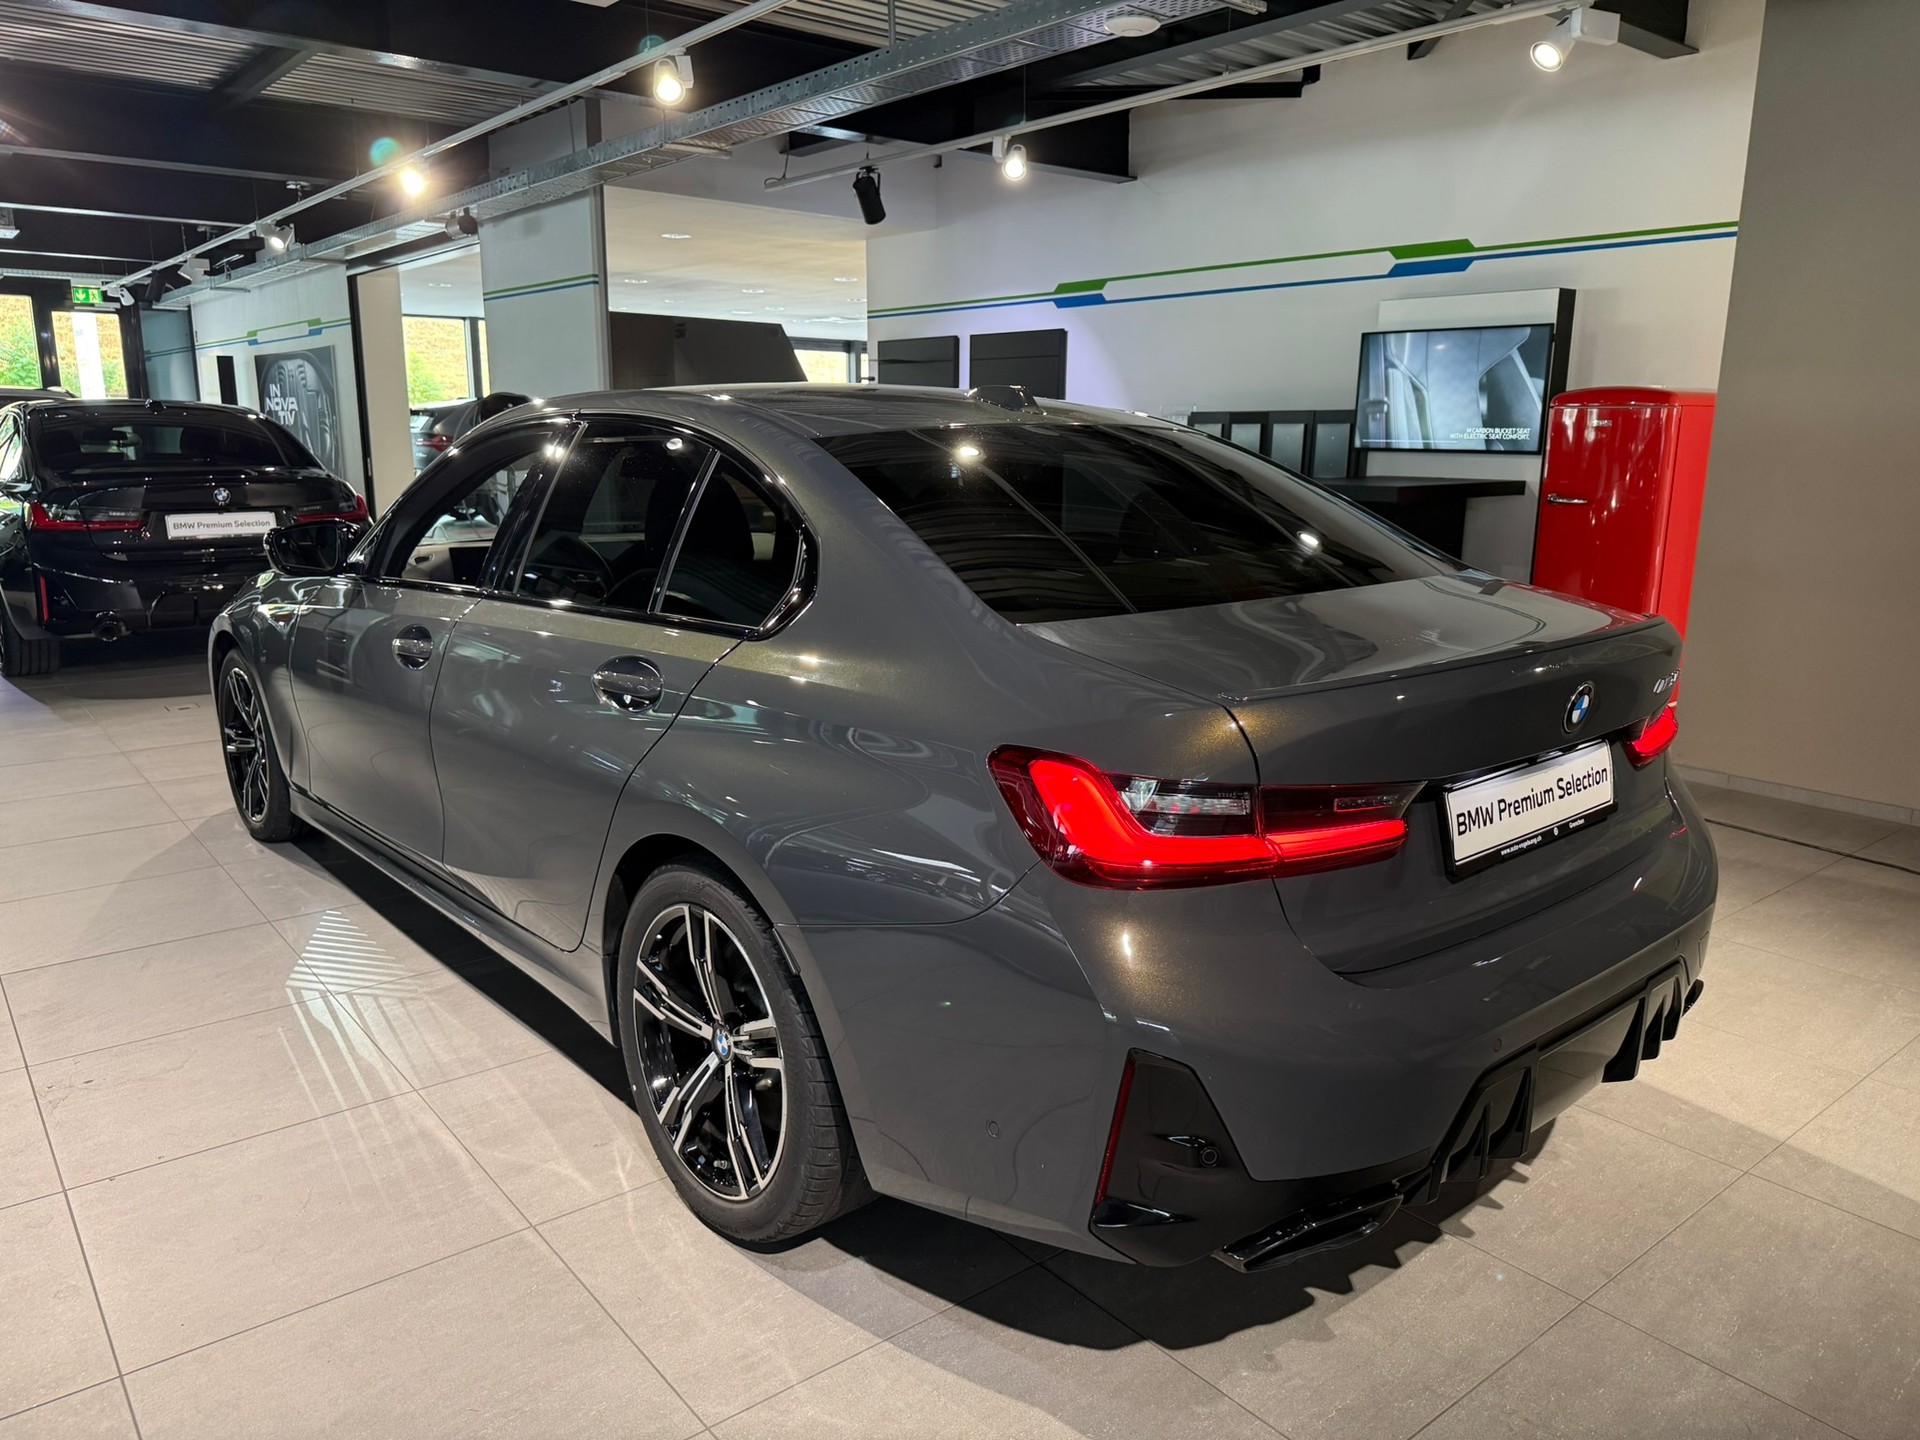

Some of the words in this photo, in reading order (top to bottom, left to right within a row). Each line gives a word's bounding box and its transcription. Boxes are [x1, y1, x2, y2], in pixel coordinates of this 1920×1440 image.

[269, 383, 281, 397] IN
[265, 397, 299, 411] NOVA
[278, 410, 295, 425] TIV
[173, 522, 195, 530] BMW
[197, 520, 233, 529] Premium
[233, 519, 271, 528] Selection
[1456, 803, 1494, 836] BMW
[1498, 787, 1555, 821] Premium
[1556, 766, 1608, 800] Selection
